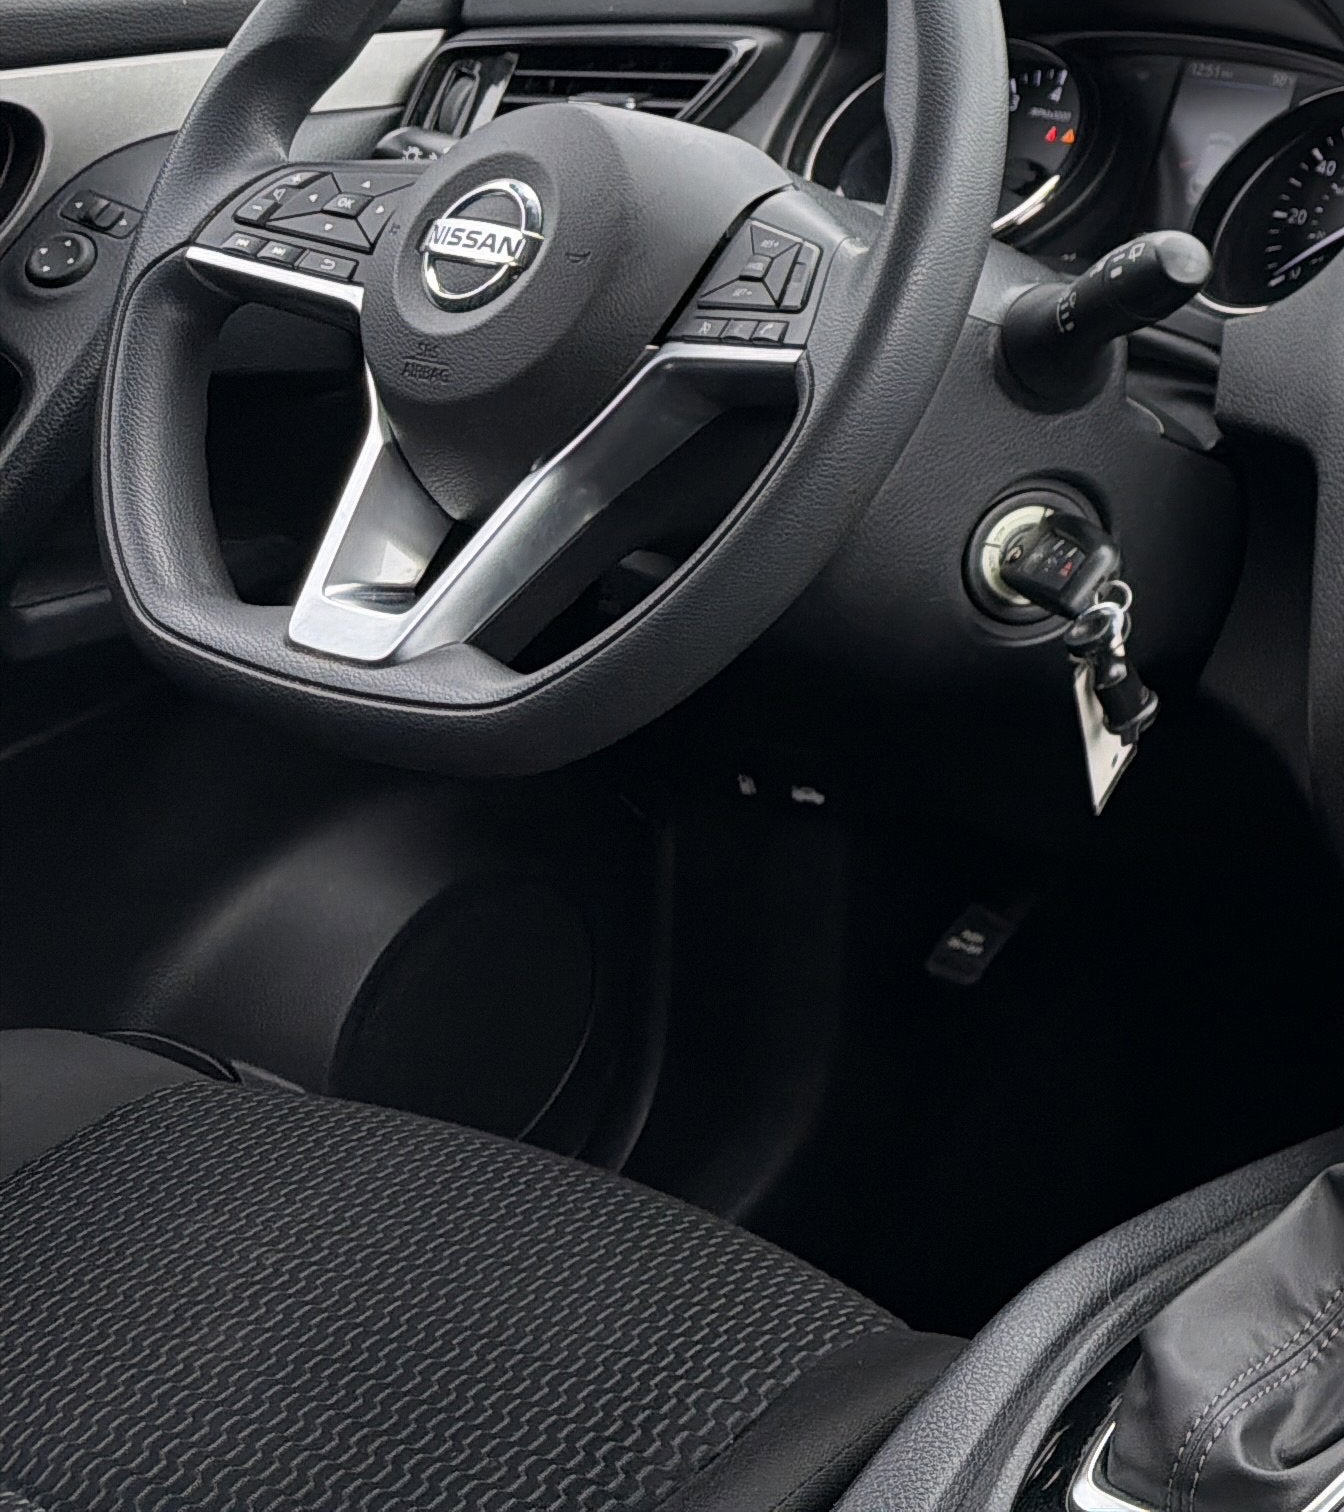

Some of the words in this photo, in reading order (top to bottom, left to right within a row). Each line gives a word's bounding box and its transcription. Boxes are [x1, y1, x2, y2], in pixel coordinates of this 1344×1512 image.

[1315, 160, 1336, 177] 40
[337, 197, 355, 209] OK
[1287, 207, 1308, 226] 20
[429, 225, 522, 257] NISSAN
